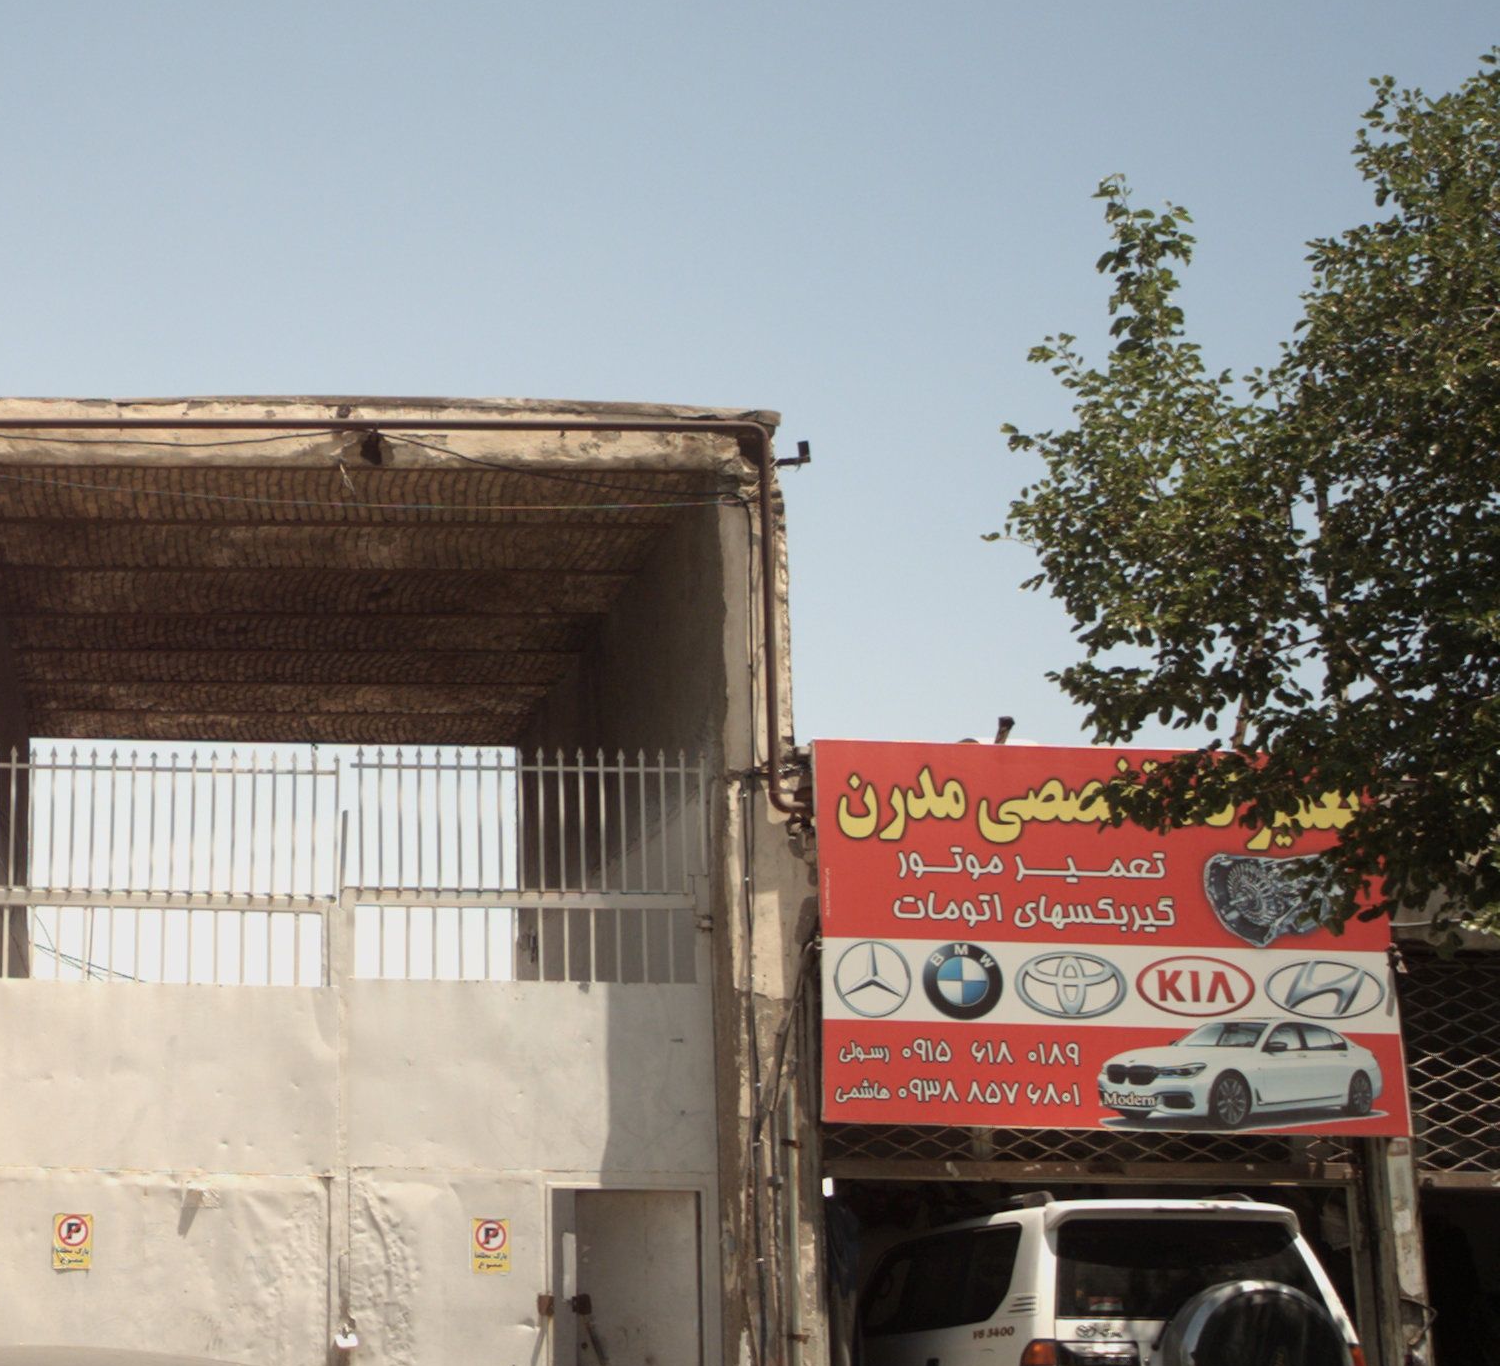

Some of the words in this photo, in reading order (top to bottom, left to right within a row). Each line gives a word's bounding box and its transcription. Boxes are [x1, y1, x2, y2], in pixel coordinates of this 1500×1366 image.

[837, 764, 966, 840] مدرن
[897, 845, 1004, 880] موتور
[1014, 851, 1166, 882] تعمیر
[892, 891, 1003, 928] اتومات
[930, 943, 995, 969] BMW
[1156, 968, 1237, 1004] KIA
[838, 1040, 891, 1064] رسولی
[902, 1038, 952, 1062] ۰۹۱۵
[971, 1040, 1015, 1064] ۶۱۸
[1027, 1042, 1080, 1066] ۰۱۸۹
[834, 1079, 891, 1103] هاشمی
[897, 1078, 960, 1102] ۰۹۳۸
[966, 1080, 1020, 1104] ۸۵۷
[1026, 1082, 1081, 1107] ۶۸۰۱
[1103, 1091, 1157, 1107] Modern
